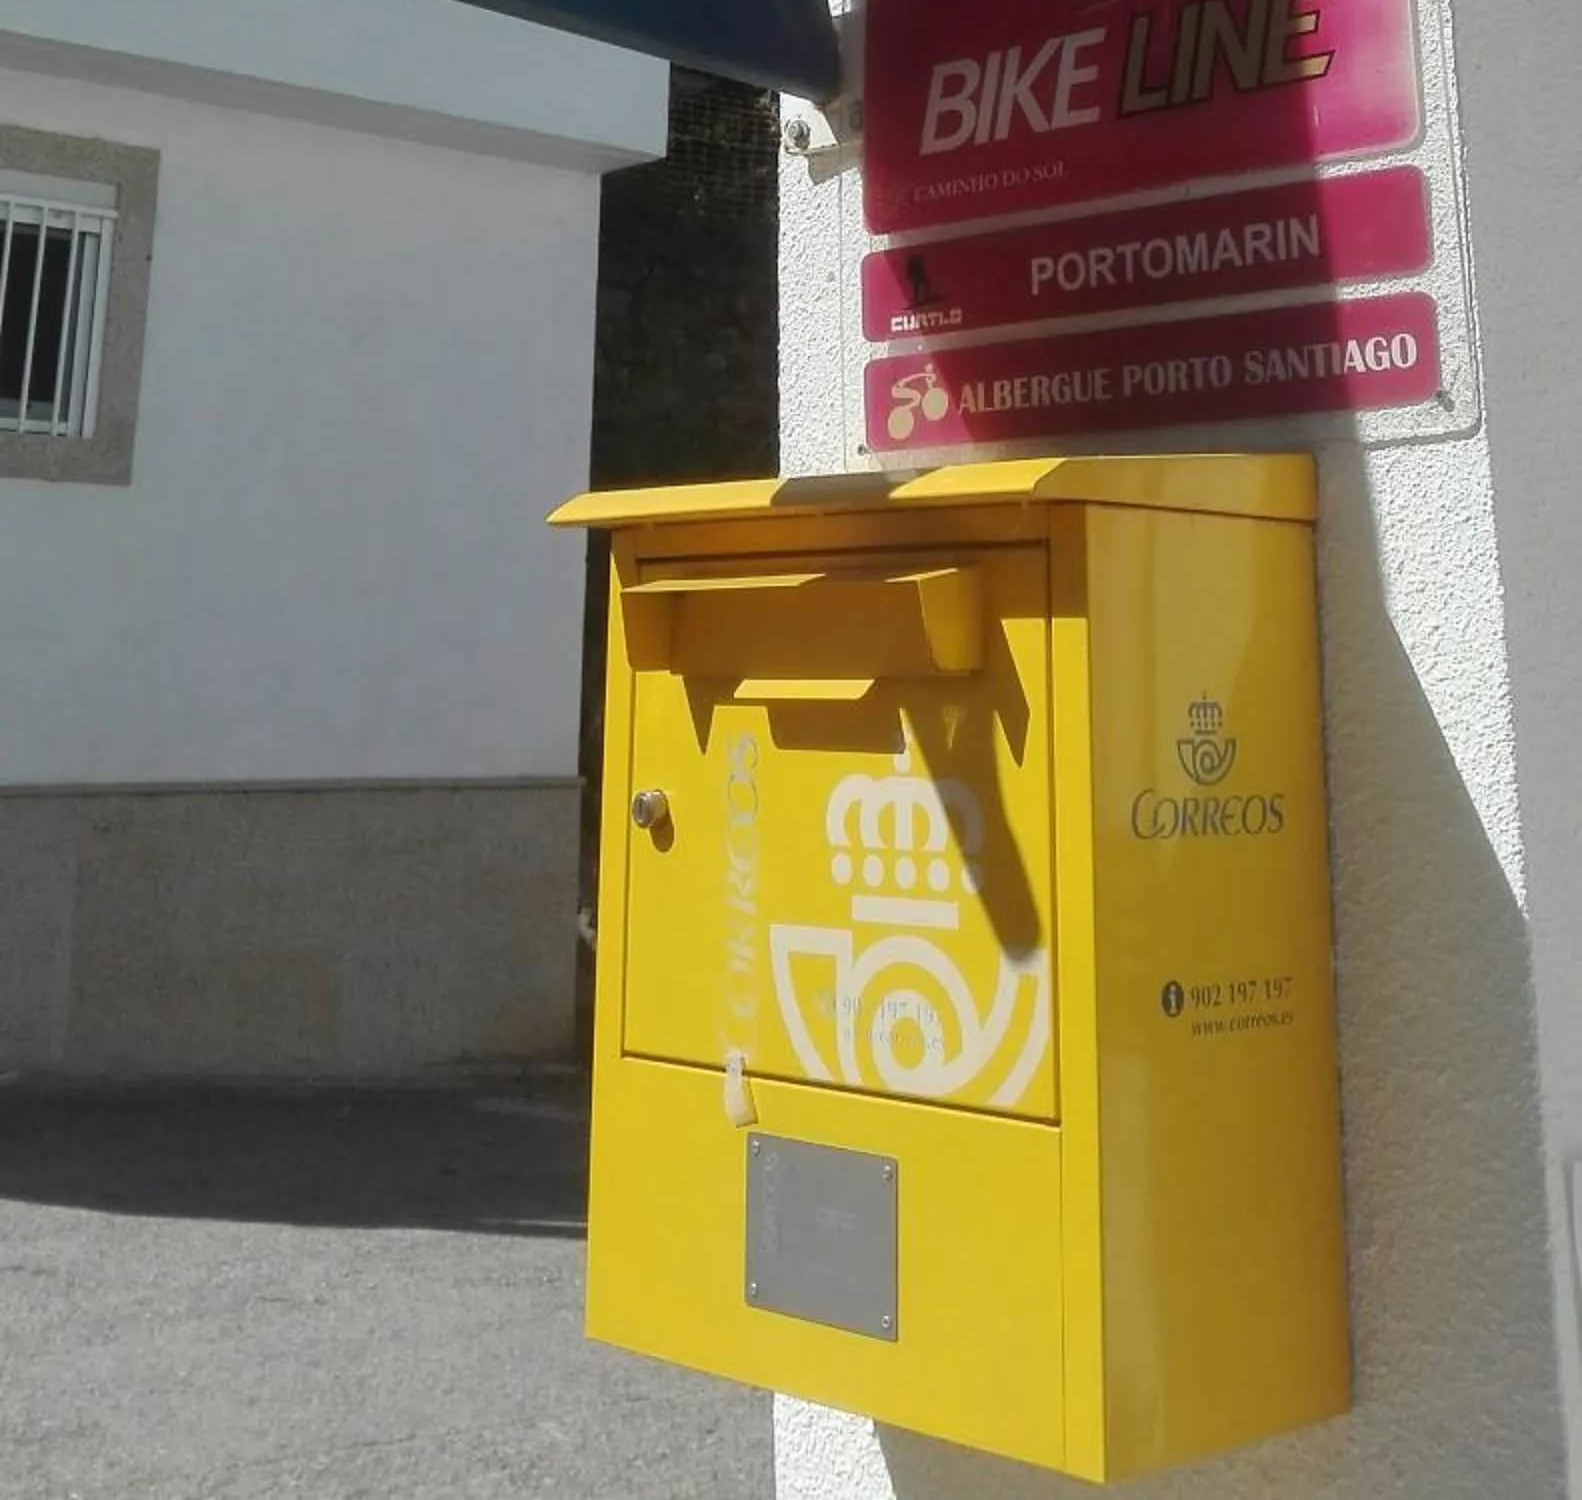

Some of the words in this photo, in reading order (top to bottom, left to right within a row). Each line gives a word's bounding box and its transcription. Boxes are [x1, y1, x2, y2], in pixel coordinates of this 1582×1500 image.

[918, 27, 1107, 157] BIKE
[1002, 168, 1030, 188] DO
[1030, 213, 1321, 296] PORTOMARIN
[958, 366, 1113, 418] ALBERGUE
[1122, 356, 1233, 397] PORTO
[1244, 332, 1418, 385] SANTIAGO
[1131, 787, 1285, 840] CORREOS
[1190, 984, 1222, 1009] 902
[1229, 979, 1258, 1005] 197
[1265, 975, 1294, 1001] 197
